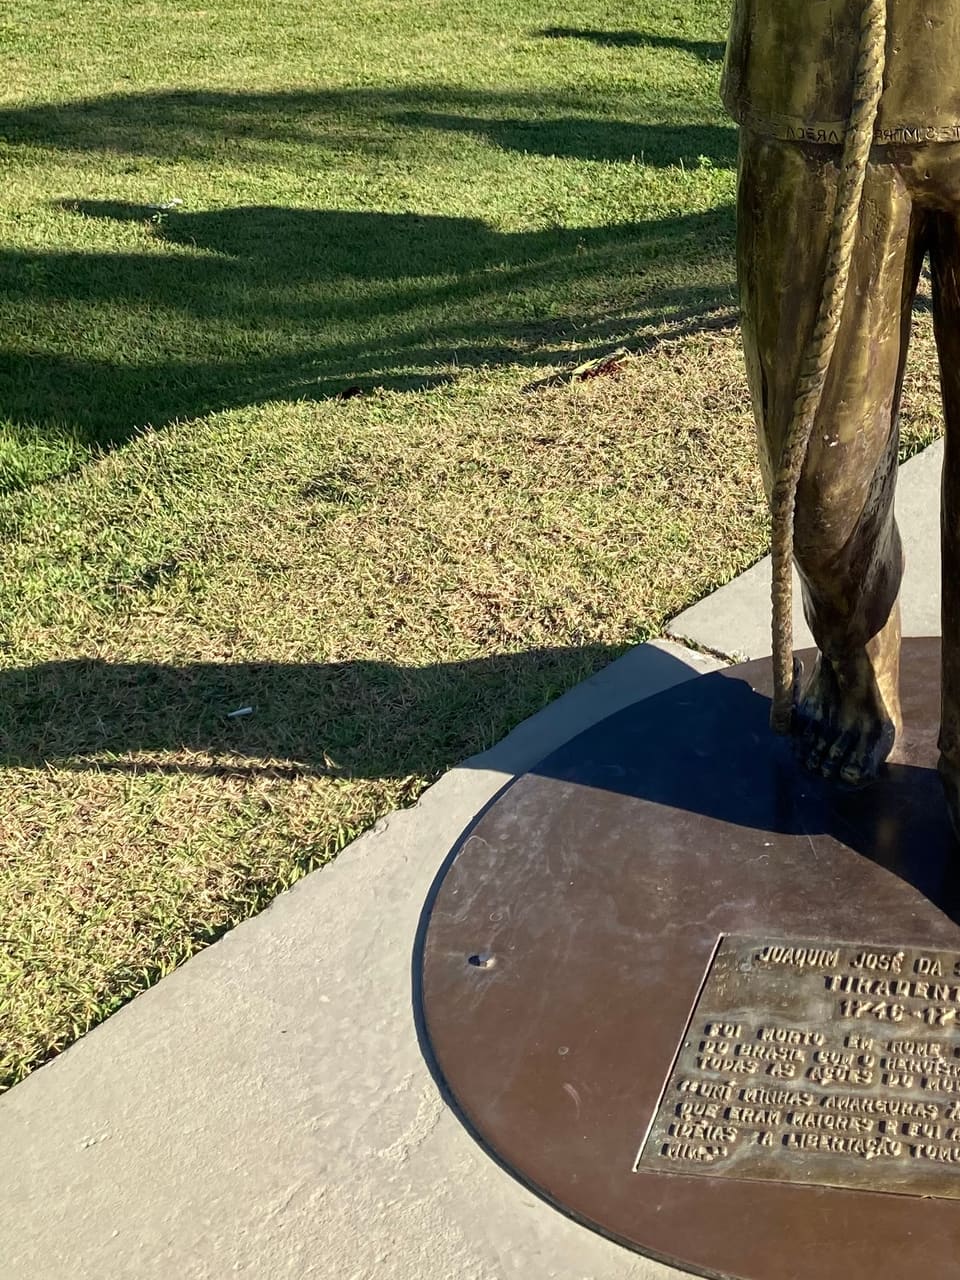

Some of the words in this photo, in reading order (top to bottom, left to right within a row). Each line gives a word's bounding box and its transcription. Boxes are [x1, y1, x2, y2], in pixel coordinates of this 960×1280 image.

[758, 946, 840, 969] JOAQUIM
[851, 951, 904, 974] JOSÉ
[914, 957, 942, 977] DA
[700, 1040, 729, 1056] DO
[734, 1043, 805, 1063] BRASIL
[813, 1050, 854, 1067] COM
[858, 1055, 875, 1069] O
[705, 1023, 742, 1039] FOI
[758, 1026, 826, 1047] MORTO
[845, 1035, 874, 1051] EM
[887, 1040, 941, 1058] NOME
[697, 1056, 760, 1075] TODAS
[767, 1062, 796, 1078] AS
[881, 1072, 913, 1089] DO
[739, 1087, 814, 1107] MINHAS
[821, 1095, 939, 1121] AMARGURAS
[676, 1102, 720, 1122] QUE
[724, 1107, 781, 1126] ERAM
[787, 1112, 874, 1132] MAIORES
[902, 1121, 941, 1140] FUI
